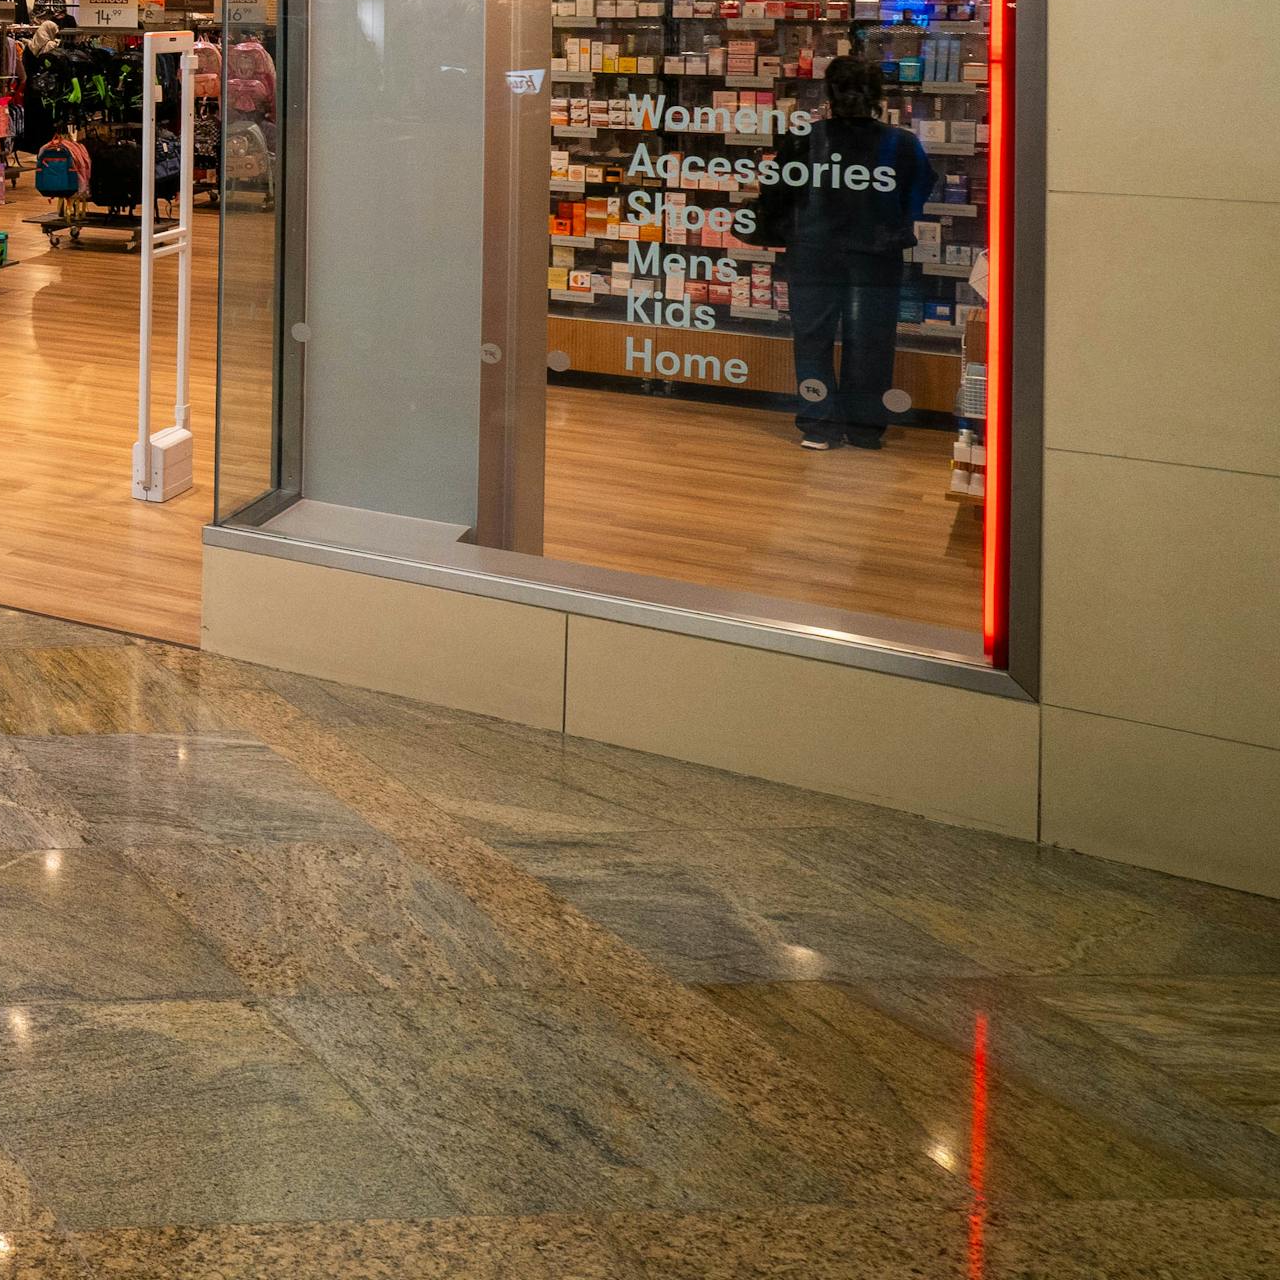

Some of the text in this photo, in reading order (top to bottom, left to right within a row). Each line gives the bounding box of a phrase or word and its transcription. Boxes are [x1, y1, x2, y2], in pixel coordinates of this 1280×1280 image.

[628, 93, 813, 136] Womens
[626, 142, 897, 193] Accessories
[626, 190, 757, 234] Shoes
[626, 239, 738, 283] Mens
[626, 288, 716, 331] Kids
[625, 336, 749, 384] Home
